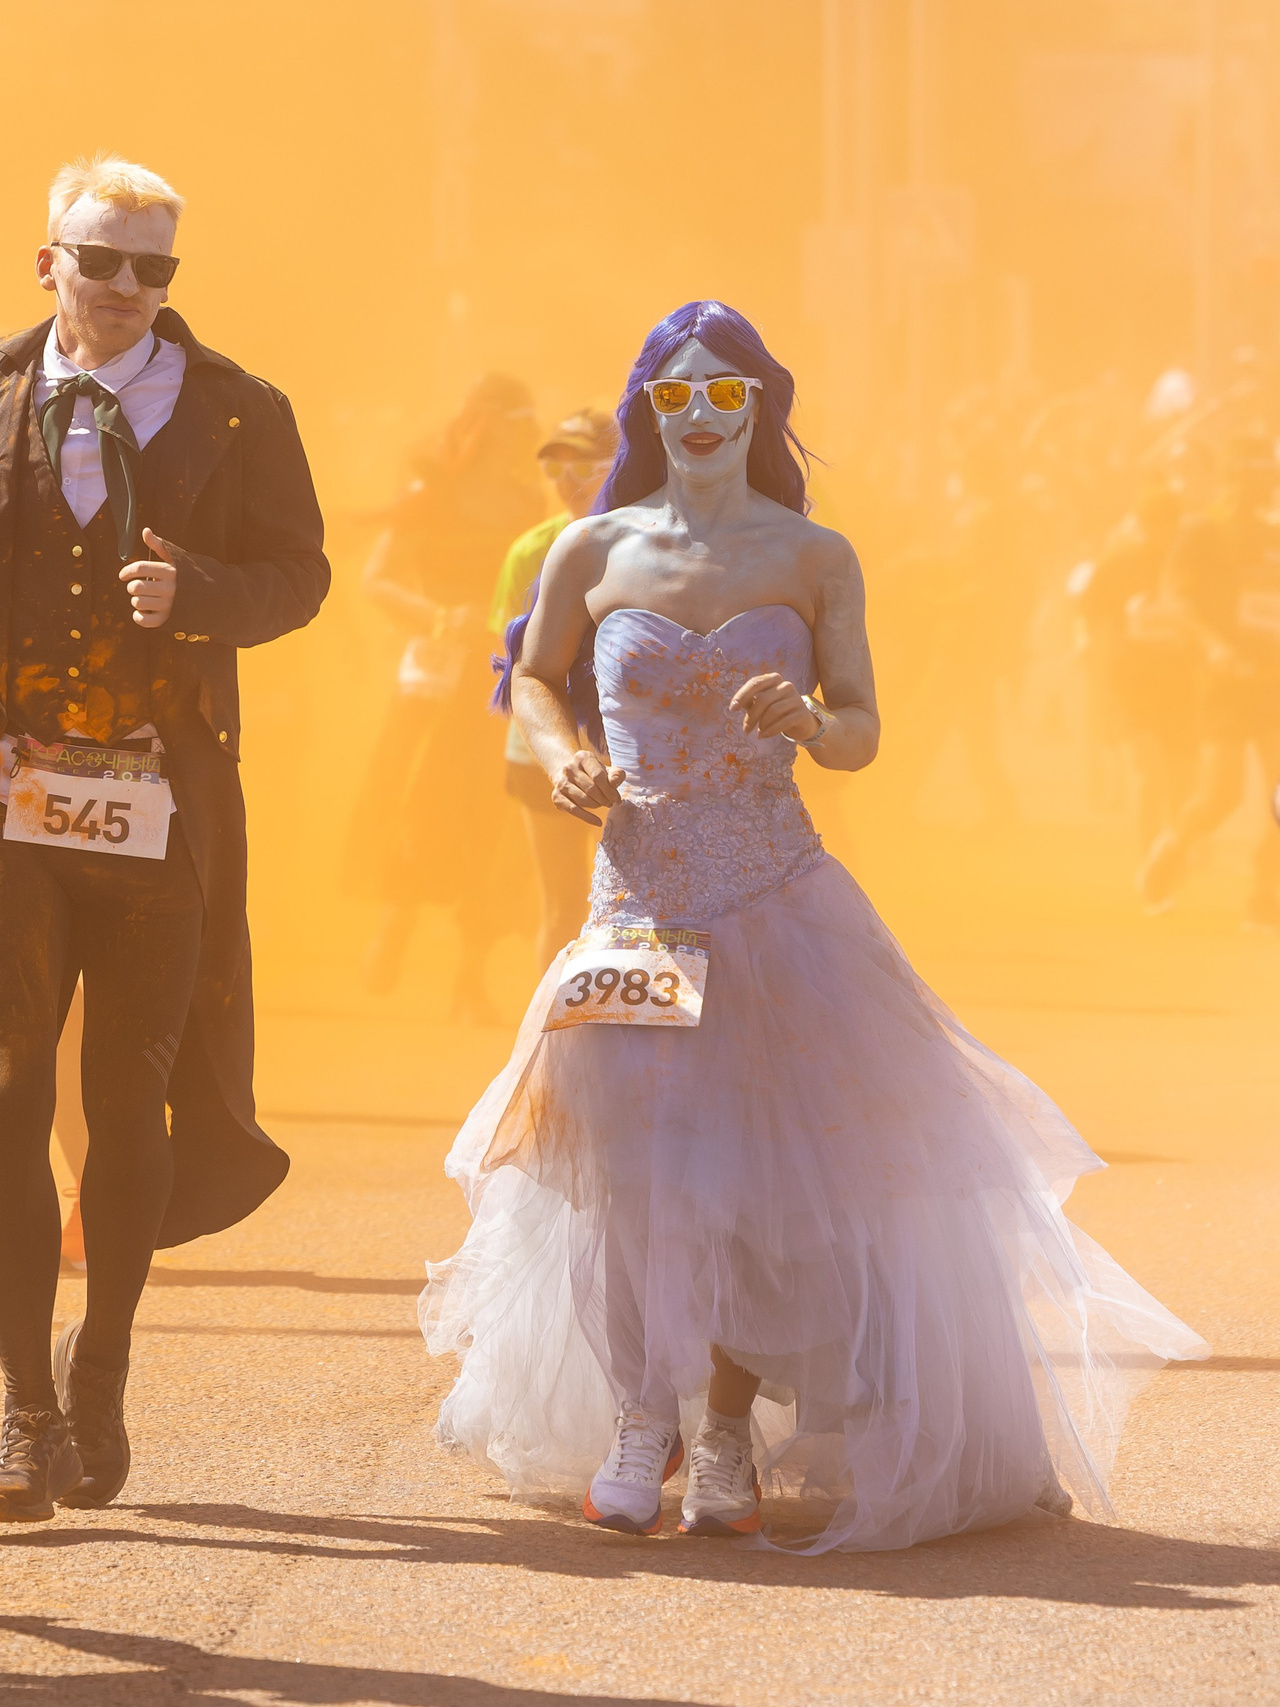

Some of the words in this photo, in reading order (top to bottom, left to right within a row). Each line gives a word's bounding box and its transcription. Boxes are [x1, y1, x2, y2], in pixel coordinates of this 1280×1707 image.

[30, 743, 161, 773] КРАСОЧНЫЙ
[43, 793, 131, 844] 545
[639, 942, 705, 958] 2026
[565, 967, 680, 1008] 3983
